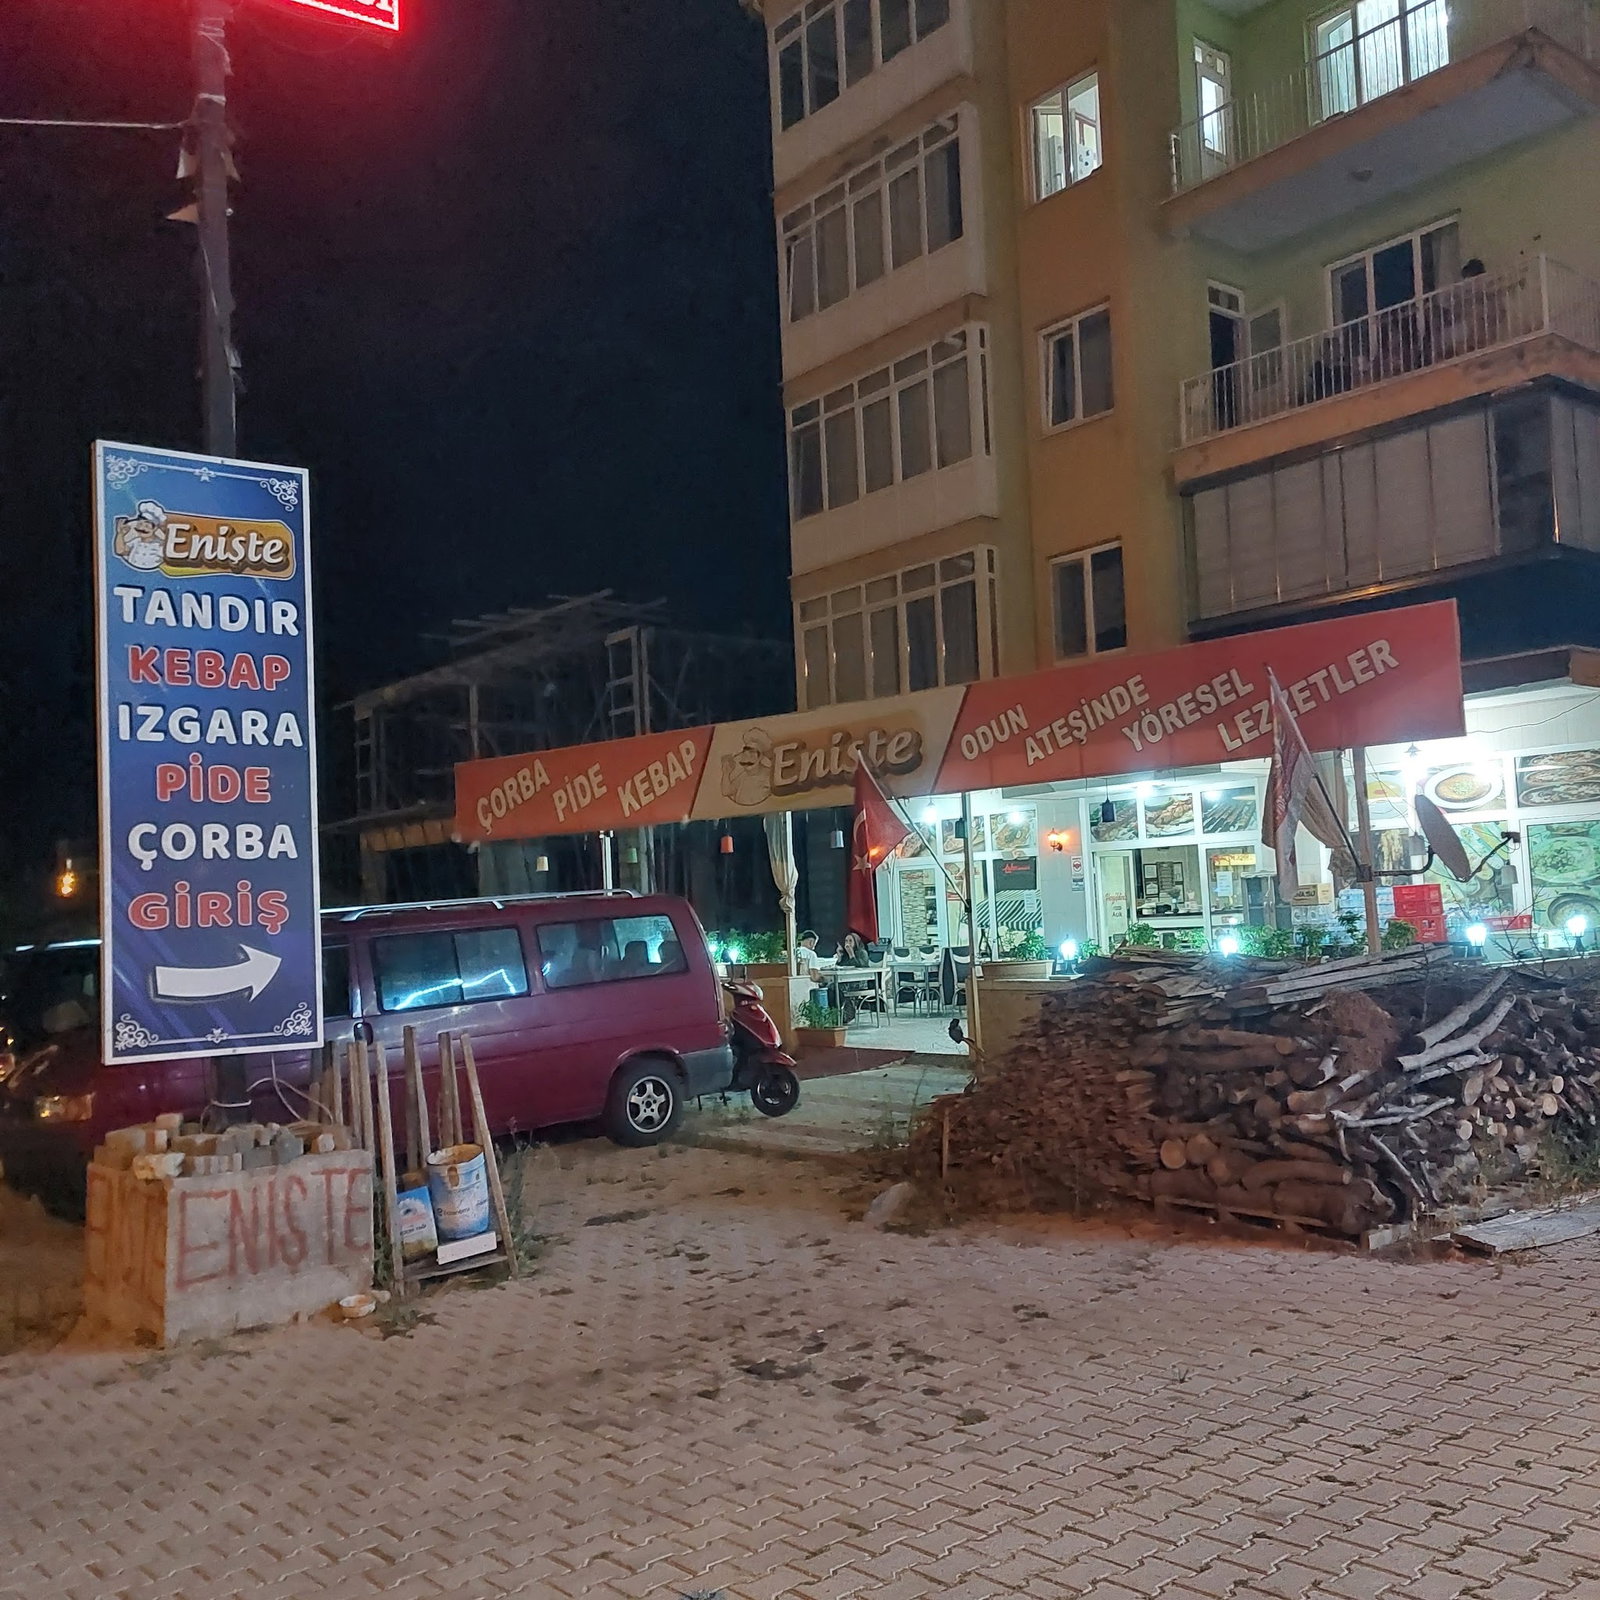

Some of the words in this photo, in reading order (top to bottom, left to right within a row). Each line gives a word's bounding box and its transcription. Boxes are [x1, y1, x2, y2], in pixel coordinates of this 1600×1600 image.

[165, 522, 285, 565] Enişte
[113, 586, 299, 636] TANDIR
[127, 644, 291, 691] KEBAP
[117, 703, 304, 747] IZGARA
[959, 704, 1030, 762] ODUN
[1024, 674, 1151, 766] ATEŞİNDE
[1121, 667, 1255, 753] YÖRESEL
[155, 752, 271, 803] PİDE
[476, 758, 551, 836] ÇORBA
[551, 763, 608, 822] PİDE
[616, 739, 698, 818] KEBAP
[127, 822, 298, 871] ÇORBA
[127, 880, 289, 935] GİRİŞ
